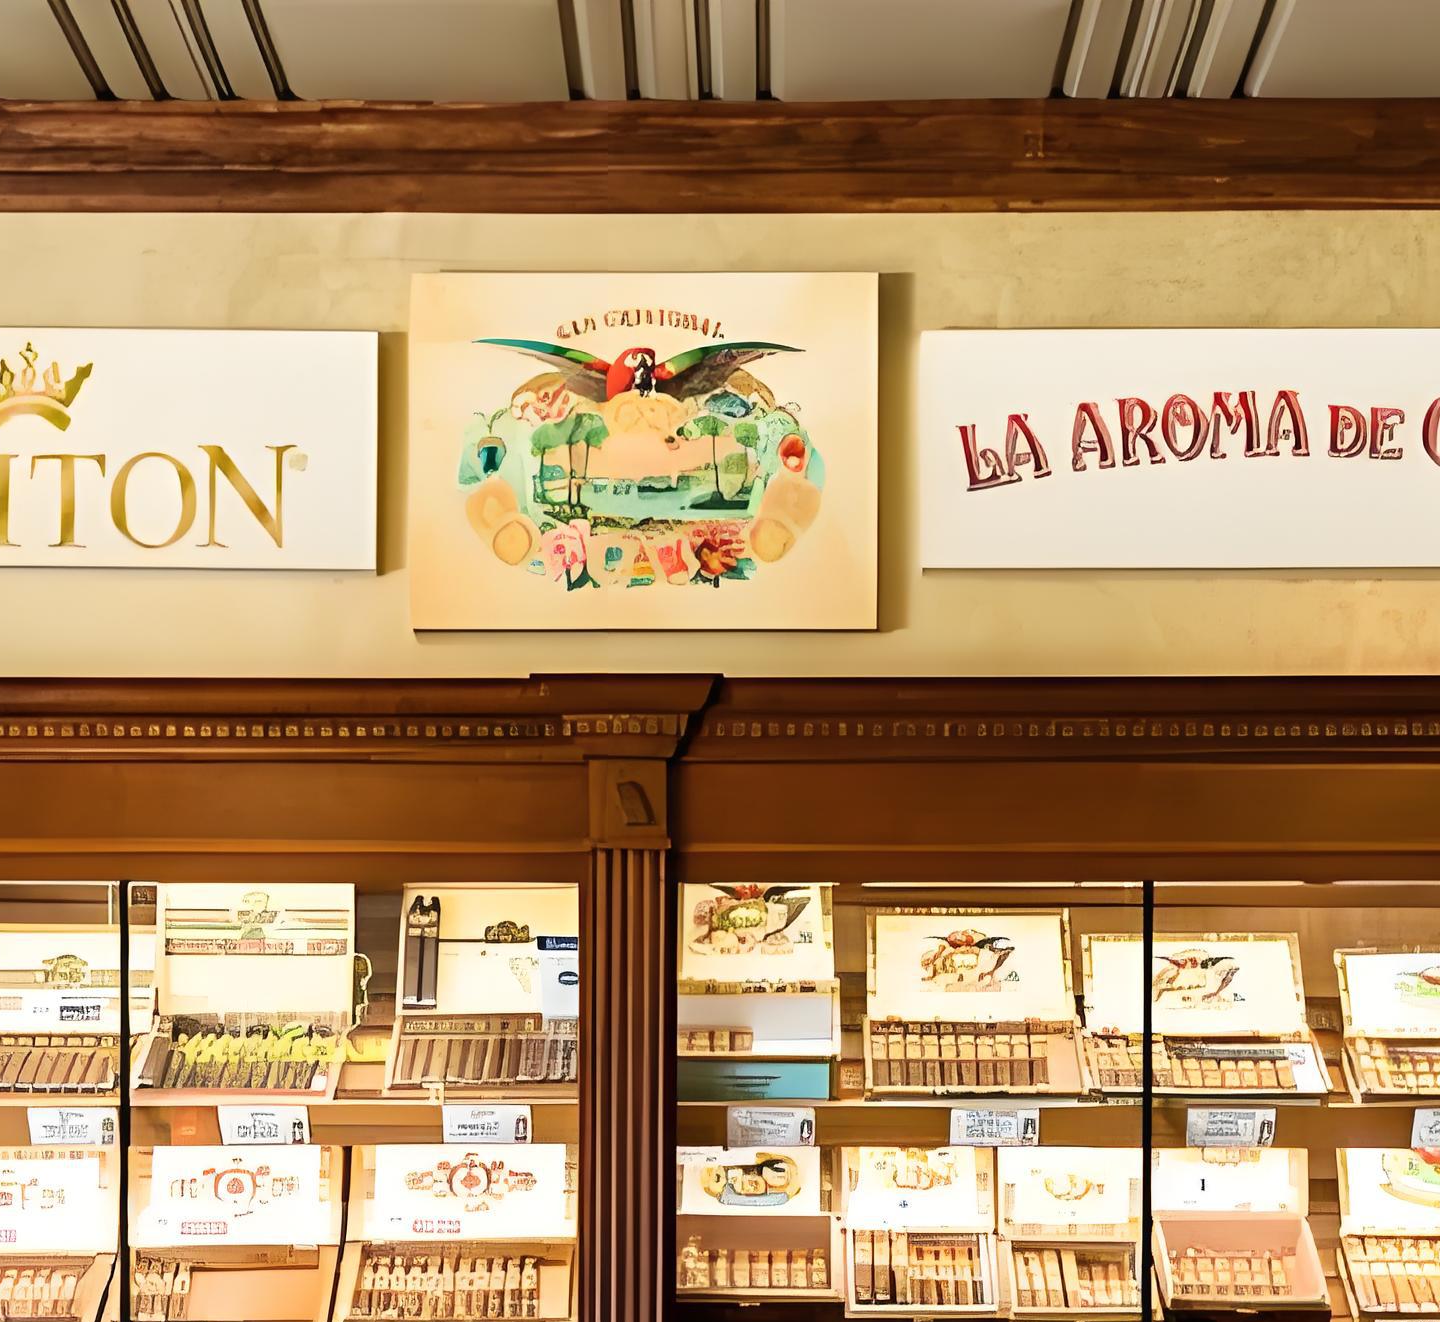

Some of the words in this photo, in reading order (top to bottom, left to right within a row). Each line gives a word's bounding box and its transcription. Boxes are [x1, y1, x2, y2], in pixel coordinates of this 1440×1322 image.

[956, 414, 1052, 492] LA
[1071, 390, 1311, 472] AROMA
[1328, 403, 1405, 460] DE
